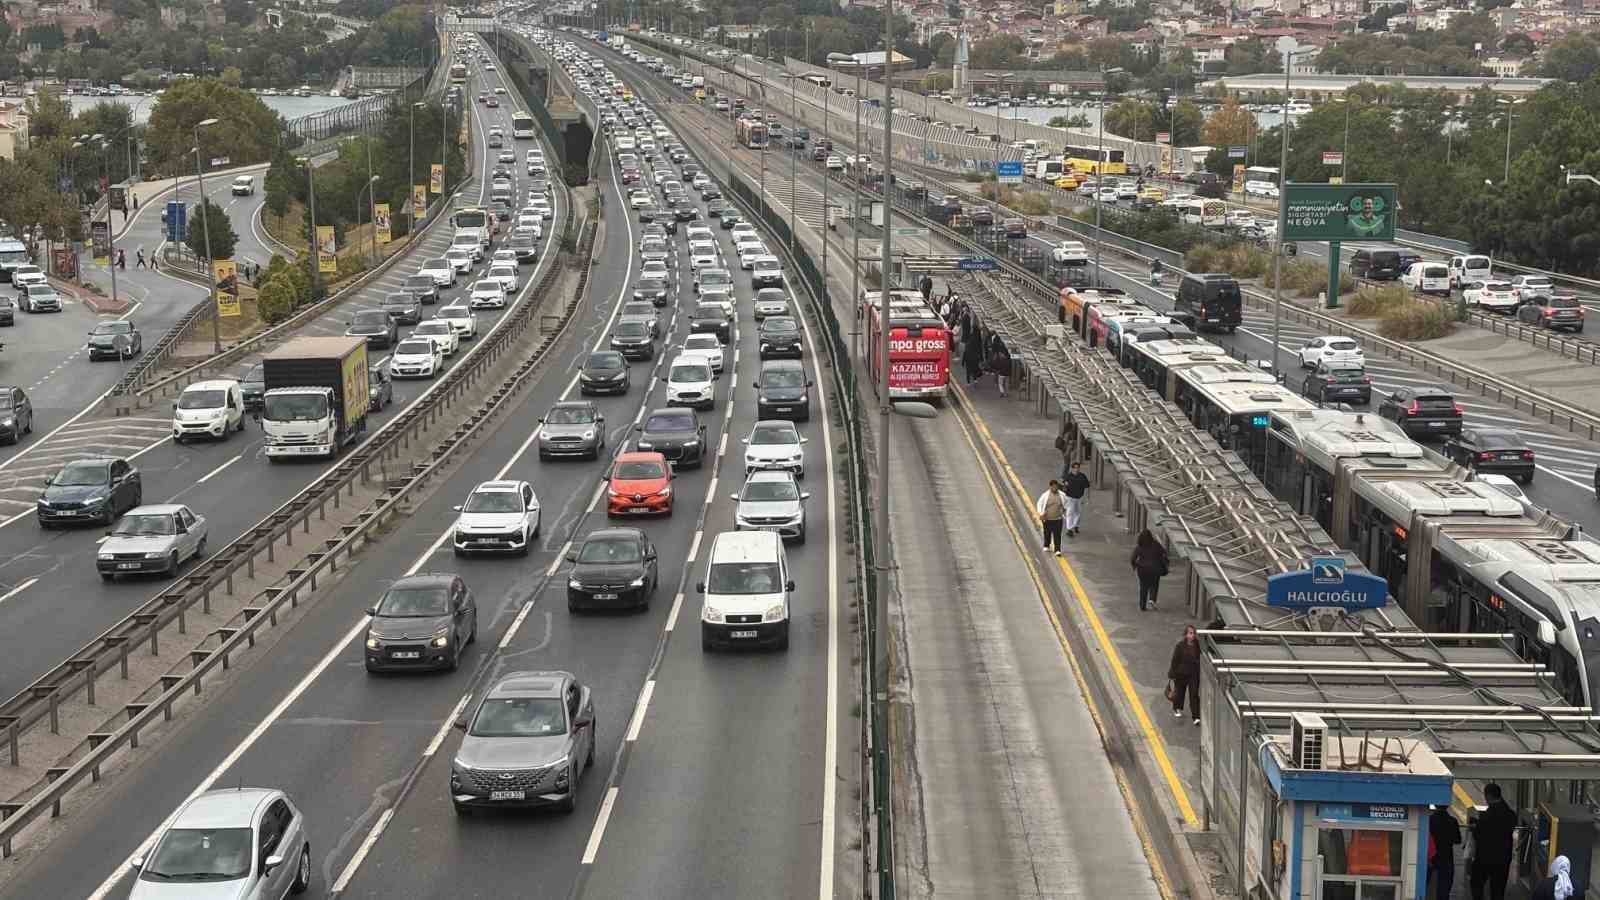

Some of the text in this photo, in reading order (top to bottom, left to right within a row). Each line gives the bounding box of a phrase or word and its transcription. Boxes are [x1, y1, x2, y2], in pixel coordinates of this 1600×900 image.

[1287, 217, 1326, 226] NEOVA
[916, 340, 946, 353] gross
[1287, 590, 1367, 602] HALICIOĞLU
[1369, 811, 1405, 819] SECURITY
